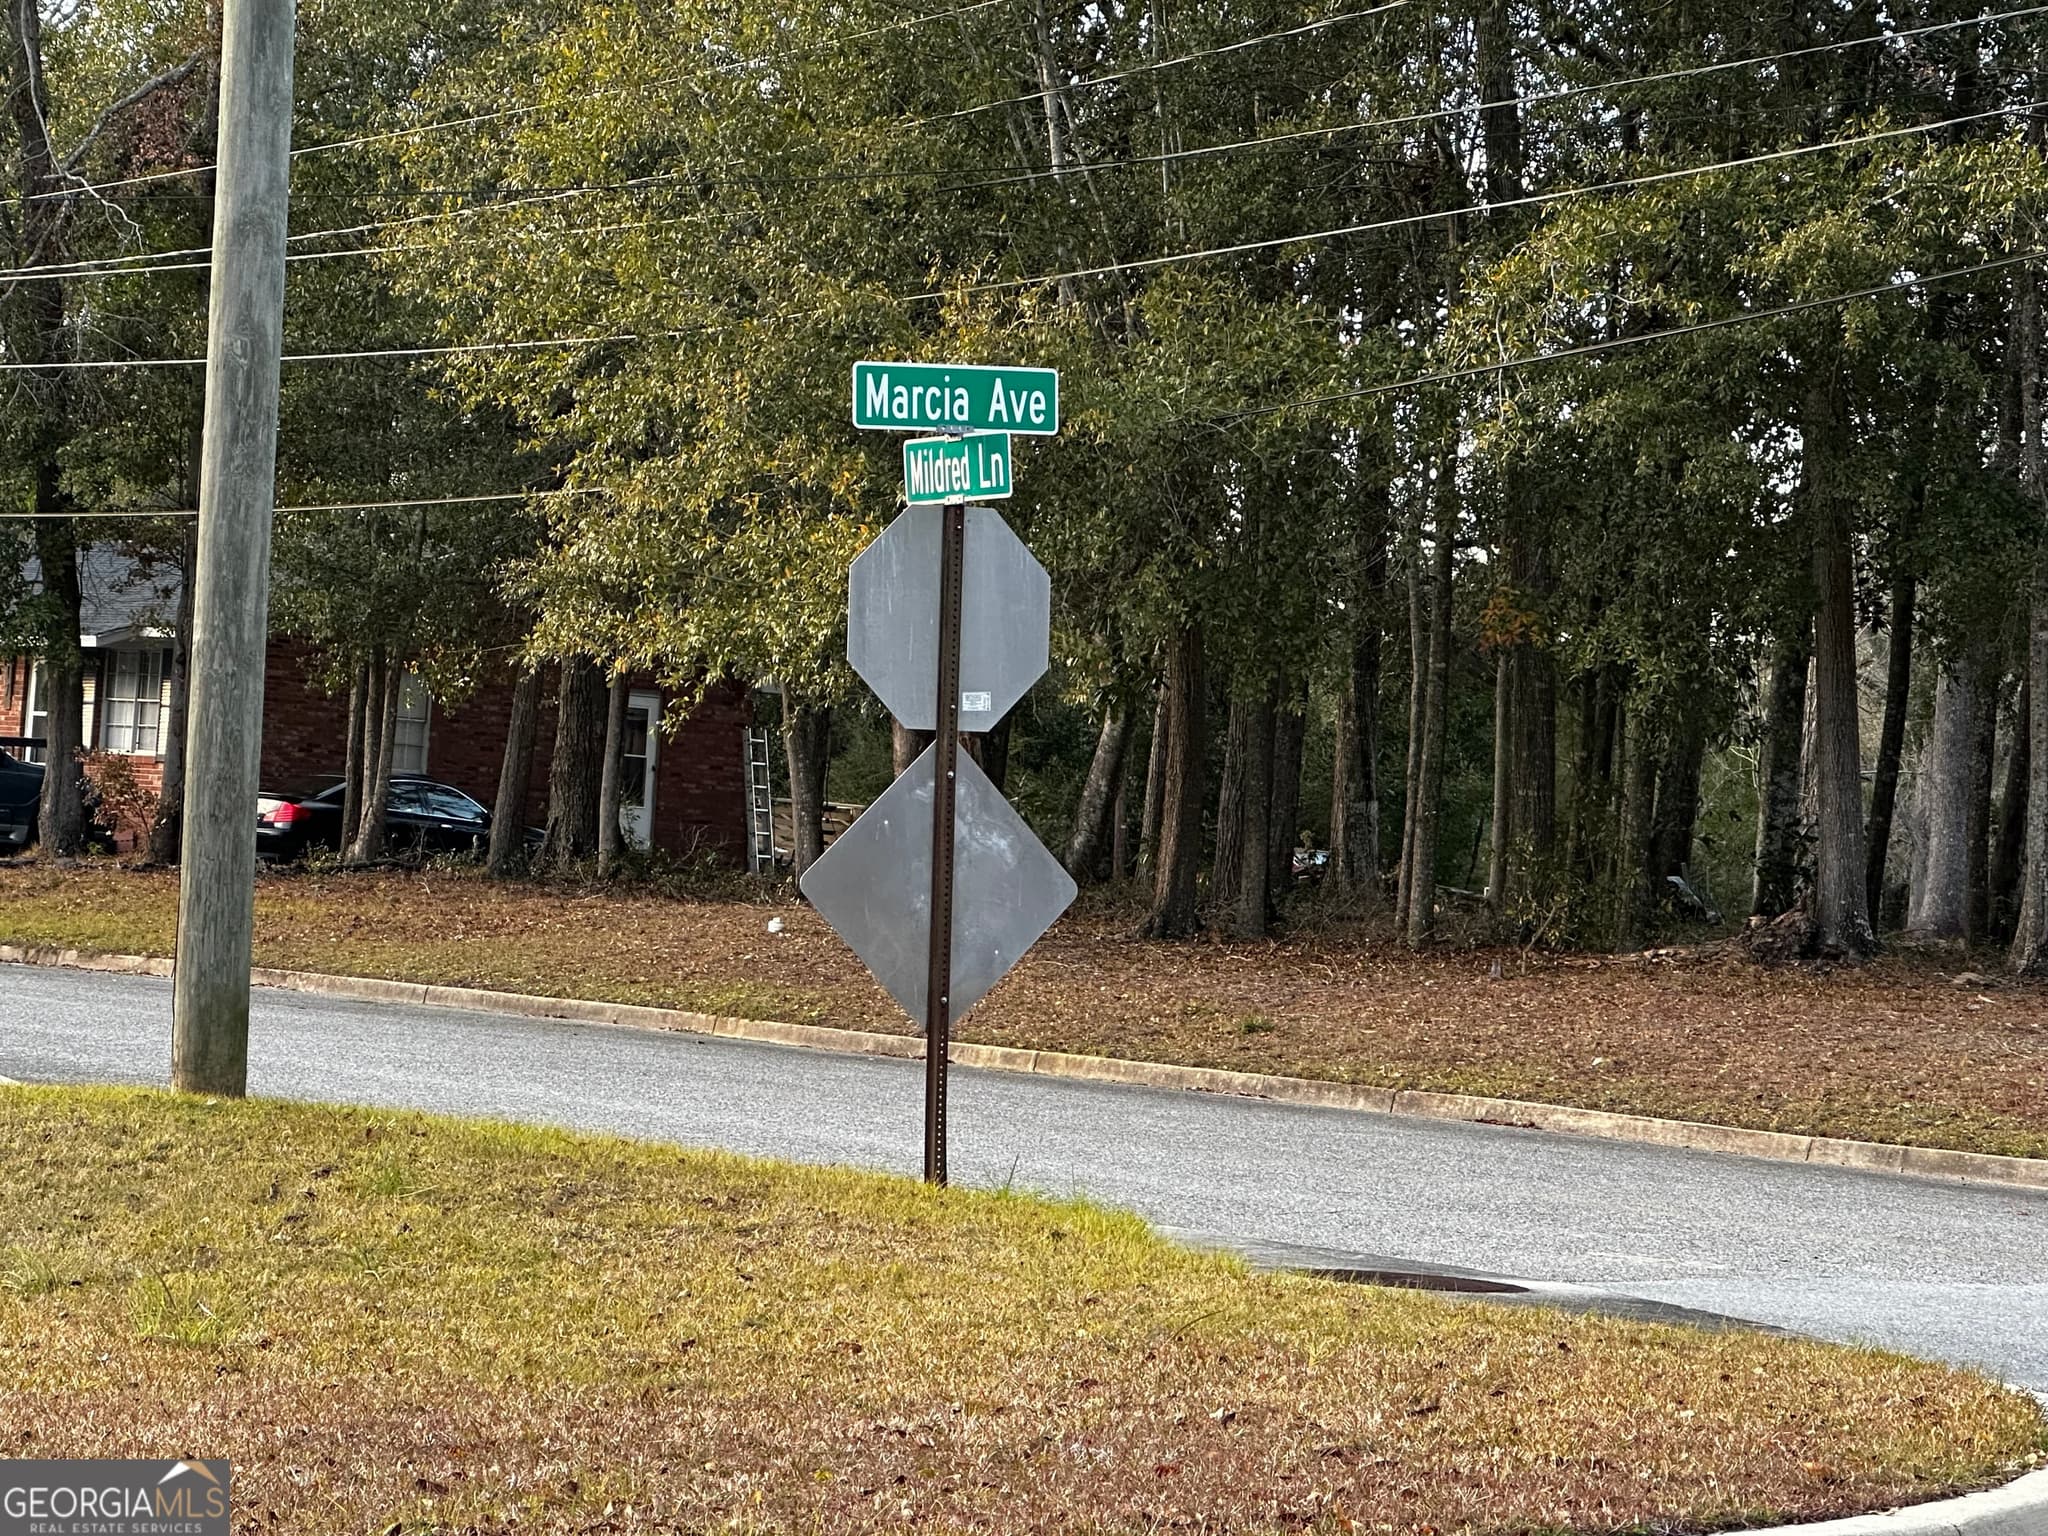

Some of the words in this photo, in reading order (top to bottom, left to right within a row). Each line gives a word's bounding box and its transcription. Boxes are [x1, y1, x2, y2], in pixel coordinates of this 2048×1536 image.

[866, 373, 969, 421] Marcia
[988, 377, 1046, 424] Ave
[909, 445, 970, 495] Mildred
[978, 443, 1004, 489] Ln
